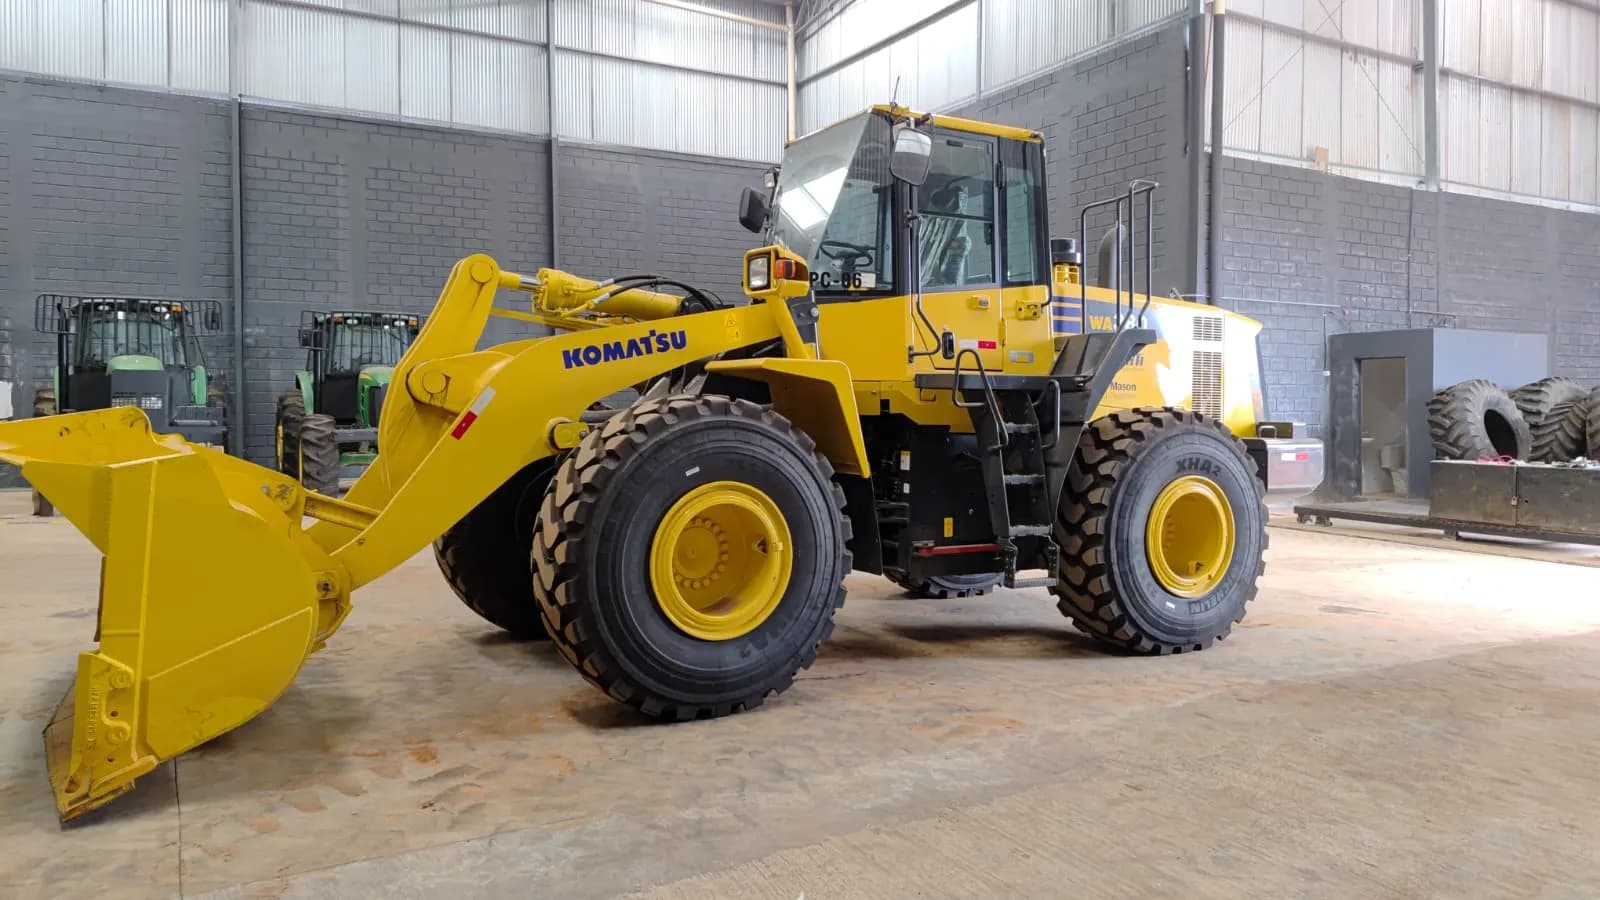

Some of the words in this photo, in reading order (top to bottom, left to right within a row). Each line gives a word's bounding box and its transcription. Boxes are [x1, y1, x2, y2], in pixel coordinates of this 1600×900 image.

[809, 271, 862, 289] PC-06
[562, 329, 687, 369] KOMATSU
[1110, 382, 1137, 392] Mason
[1175, 457, 1222, 477] XHA2
